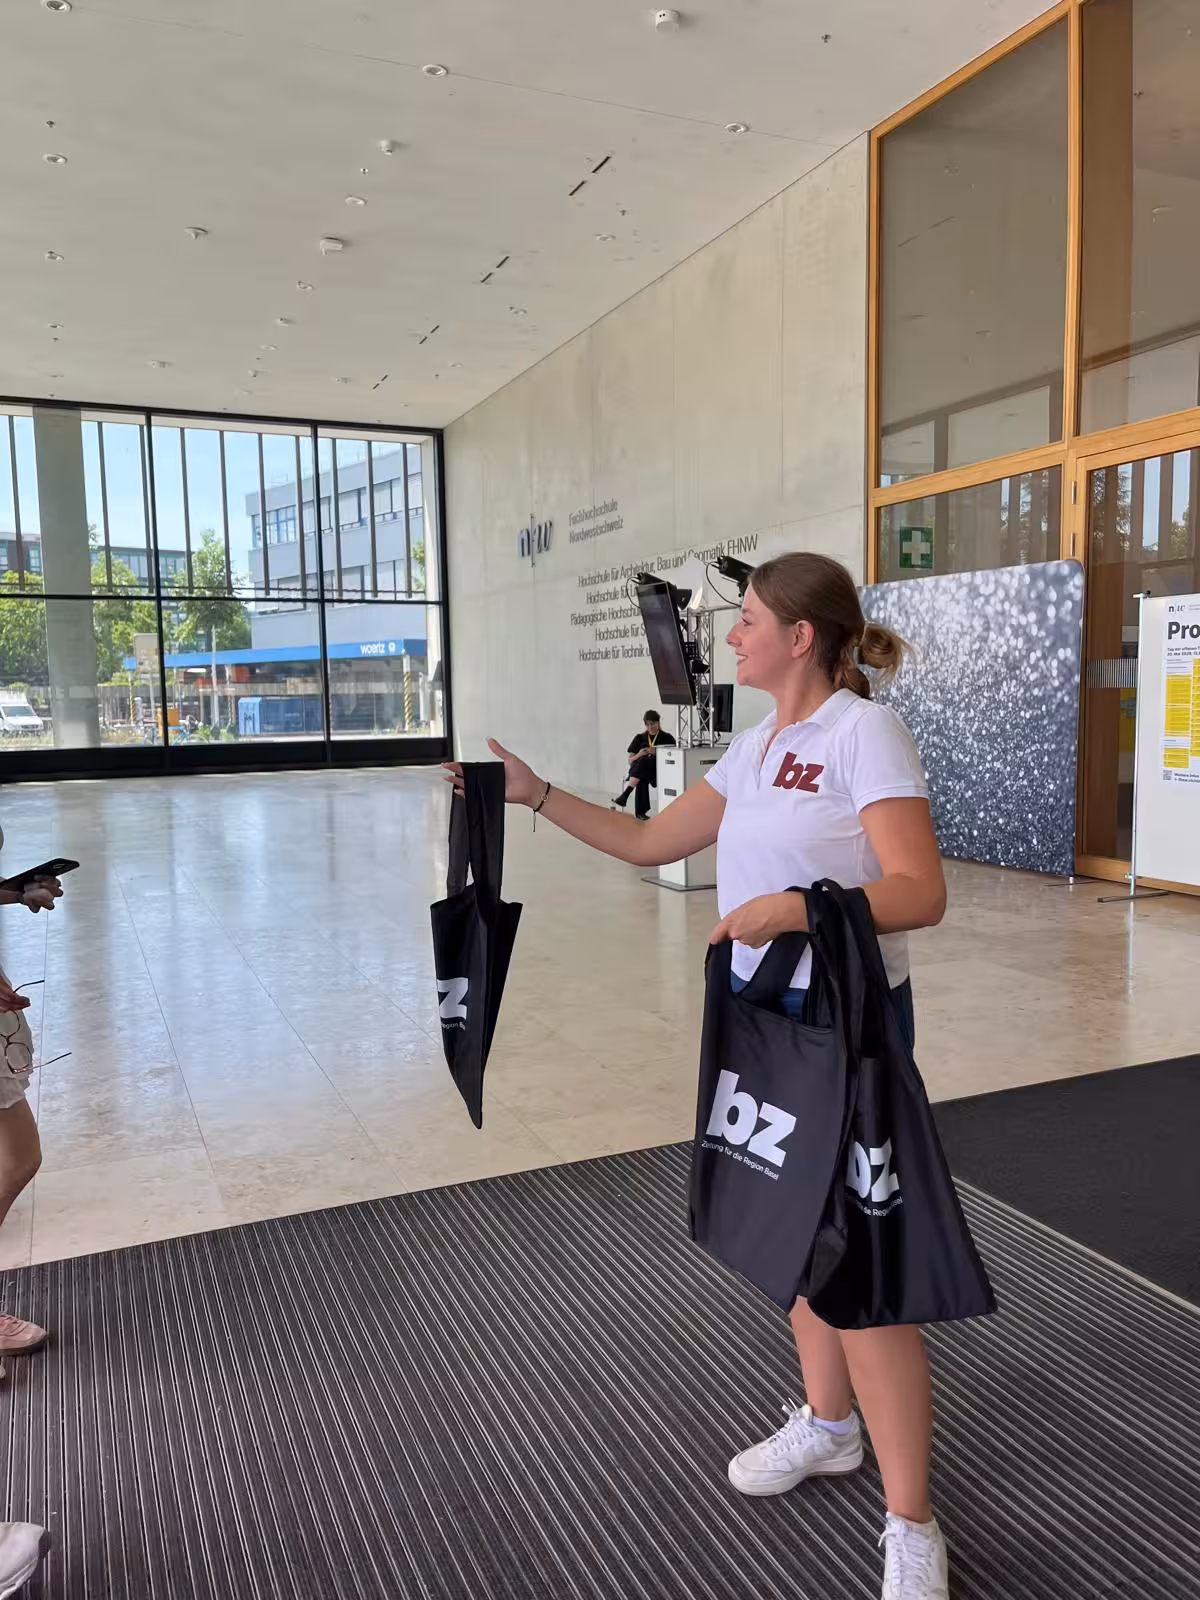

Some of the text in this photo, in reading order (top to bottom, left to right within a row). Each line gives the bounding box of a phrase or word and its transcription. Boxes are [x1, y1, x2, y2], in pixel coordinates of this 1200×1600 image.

[569, 498, 618, 527] Fachhochschule
[569, 515, 624, 544] Nordwestschweiz
[578, 568, 610, 588] Hochschule
[611, 567, 619, 582] für
[657, 556, 671, 571] Bau
[672, 552, 686, 568] und
[727, 534, 758, 555] FHNW
[586, 587, 620, 605] Hochschule
[570, 609, 607, 627] Pädagogische
[595, 625, 629, 641] Hochschule
[630, 624, 639, 637] für
[1167, 621, 1200, 640] Pro
[579, 647, 611, 661] Hochschule
[612, 646, 620, 660] für
[621, 644, 645, 659] Technik
[772, 751, 825, 793] bz
[436, 977, 469, 1020] z
[706, 1069, 797, 1168] bz
[701, 1140, 780, 1181] Zeitung für die Region Basel
